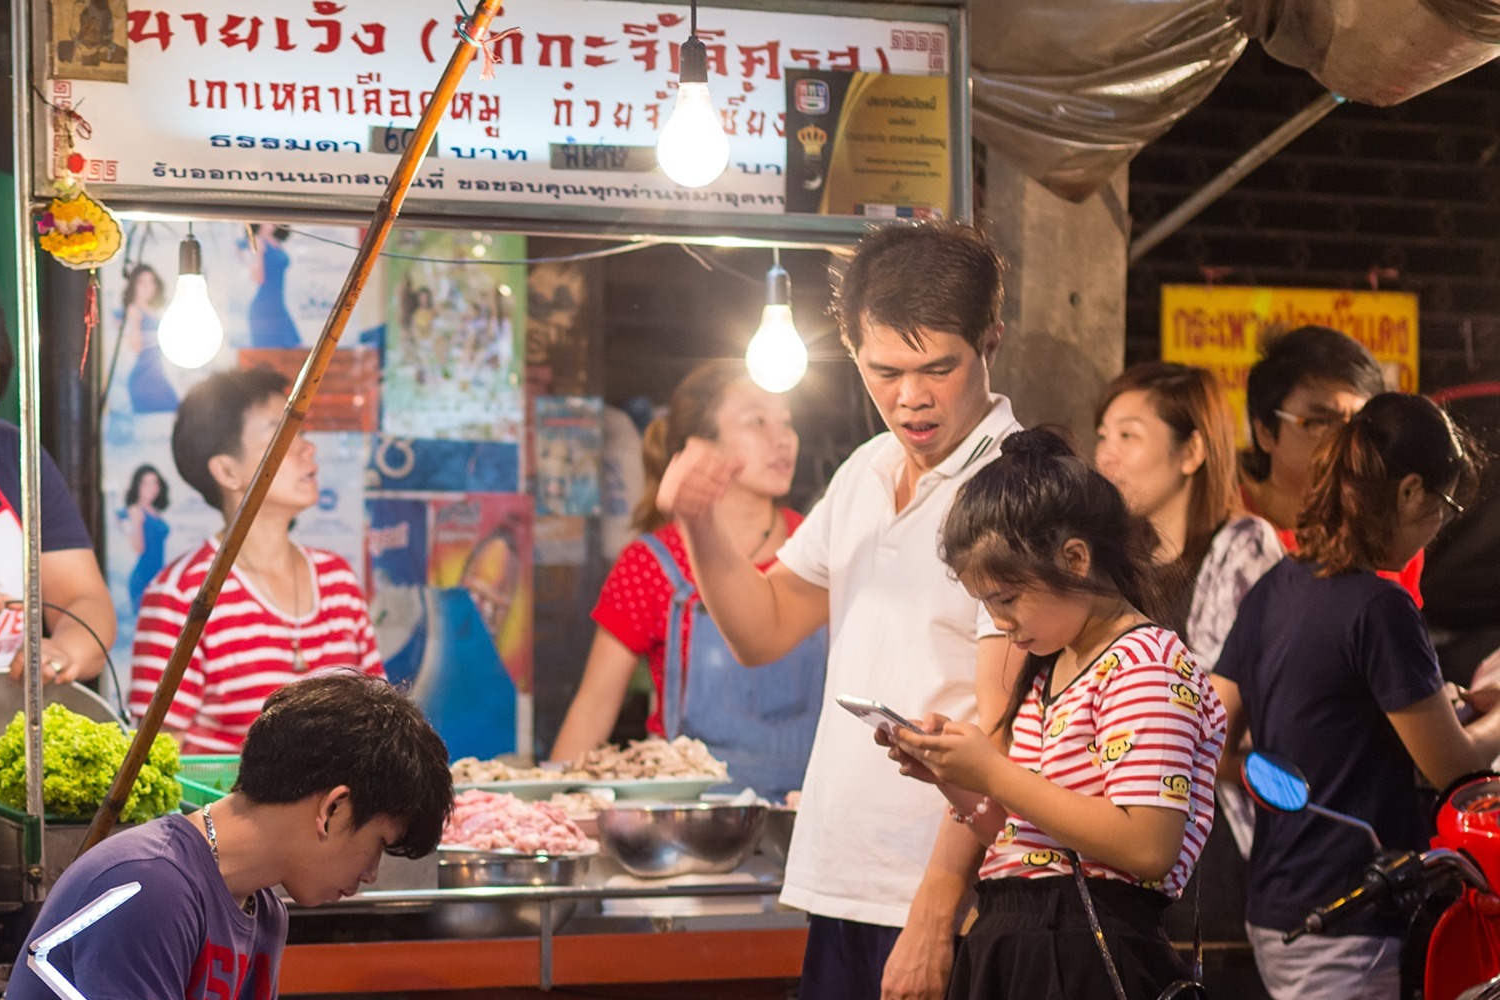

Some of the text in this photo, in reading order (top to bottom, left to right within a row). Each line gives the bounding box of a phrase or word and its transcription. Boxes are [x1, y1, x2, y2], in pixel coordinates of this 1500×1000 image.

[127, 1, 386, 55] นายเว้ง
[188, 72, 500, 138] เกาเหลาเลือดหมู
[152, 161, 444, 190] รับออกงานนอกสถนที่
[209, 133, 362, 153] ธรรมดา
[450, 143, 528, 161] บาท
[736, 162, 784, 176] บา
